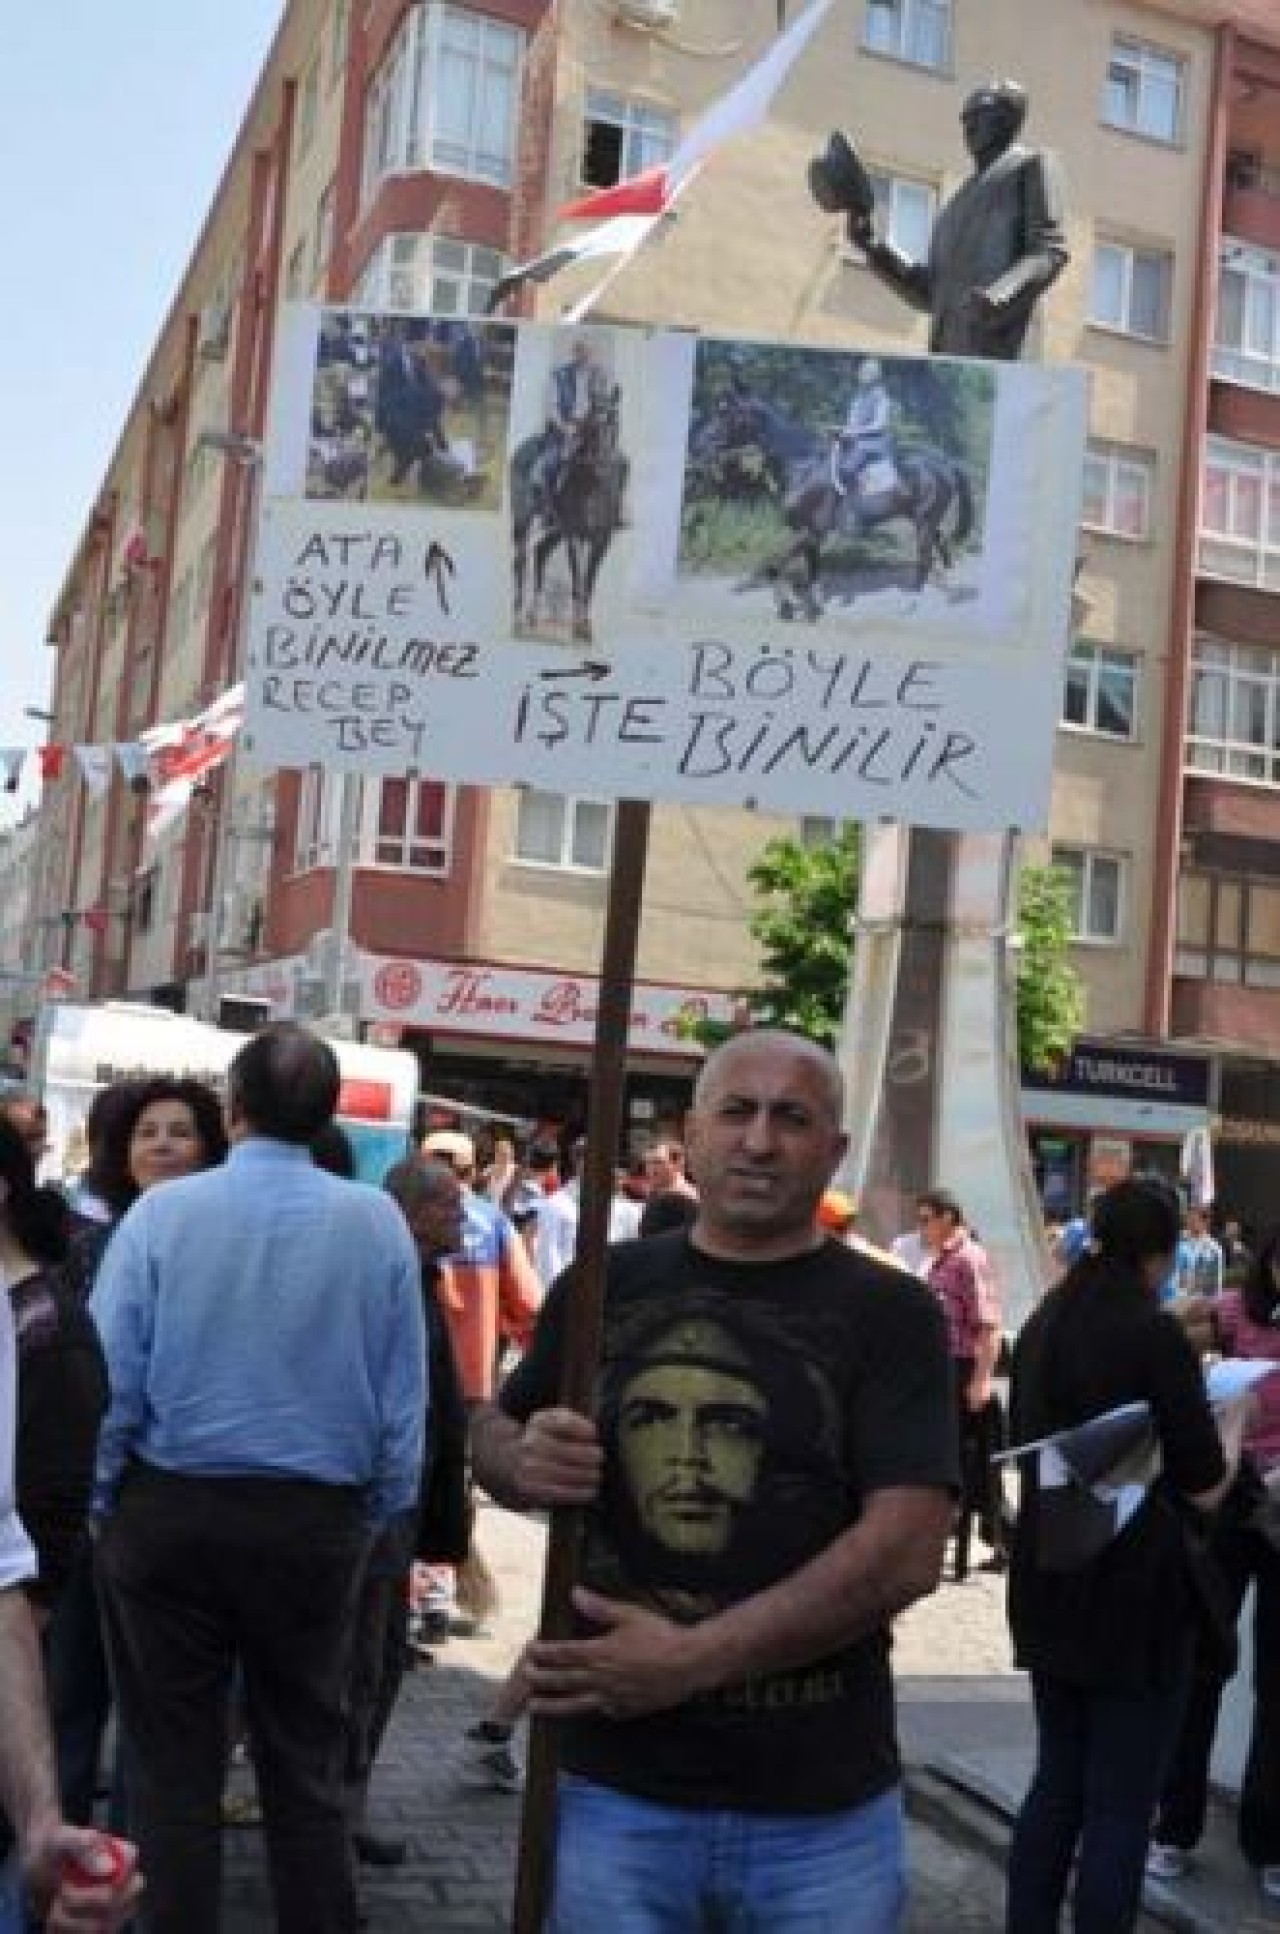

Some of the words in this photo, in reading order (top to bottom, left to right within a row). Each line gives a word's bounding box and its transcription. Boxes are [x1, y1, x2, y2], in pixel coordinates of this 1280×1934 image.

[282, 576, 416, 619] ÖYLE
[265, 623, 480, 678] BİNİLMEZ
[687, 641, 946, 711] BÖYLE
[262, 676, 412, 713] RECEP
[513, 684, 668, 750] İŞTE
[327, 714, 426, 757] BEY
[677, 710, 986, 800] BİNİLİR
